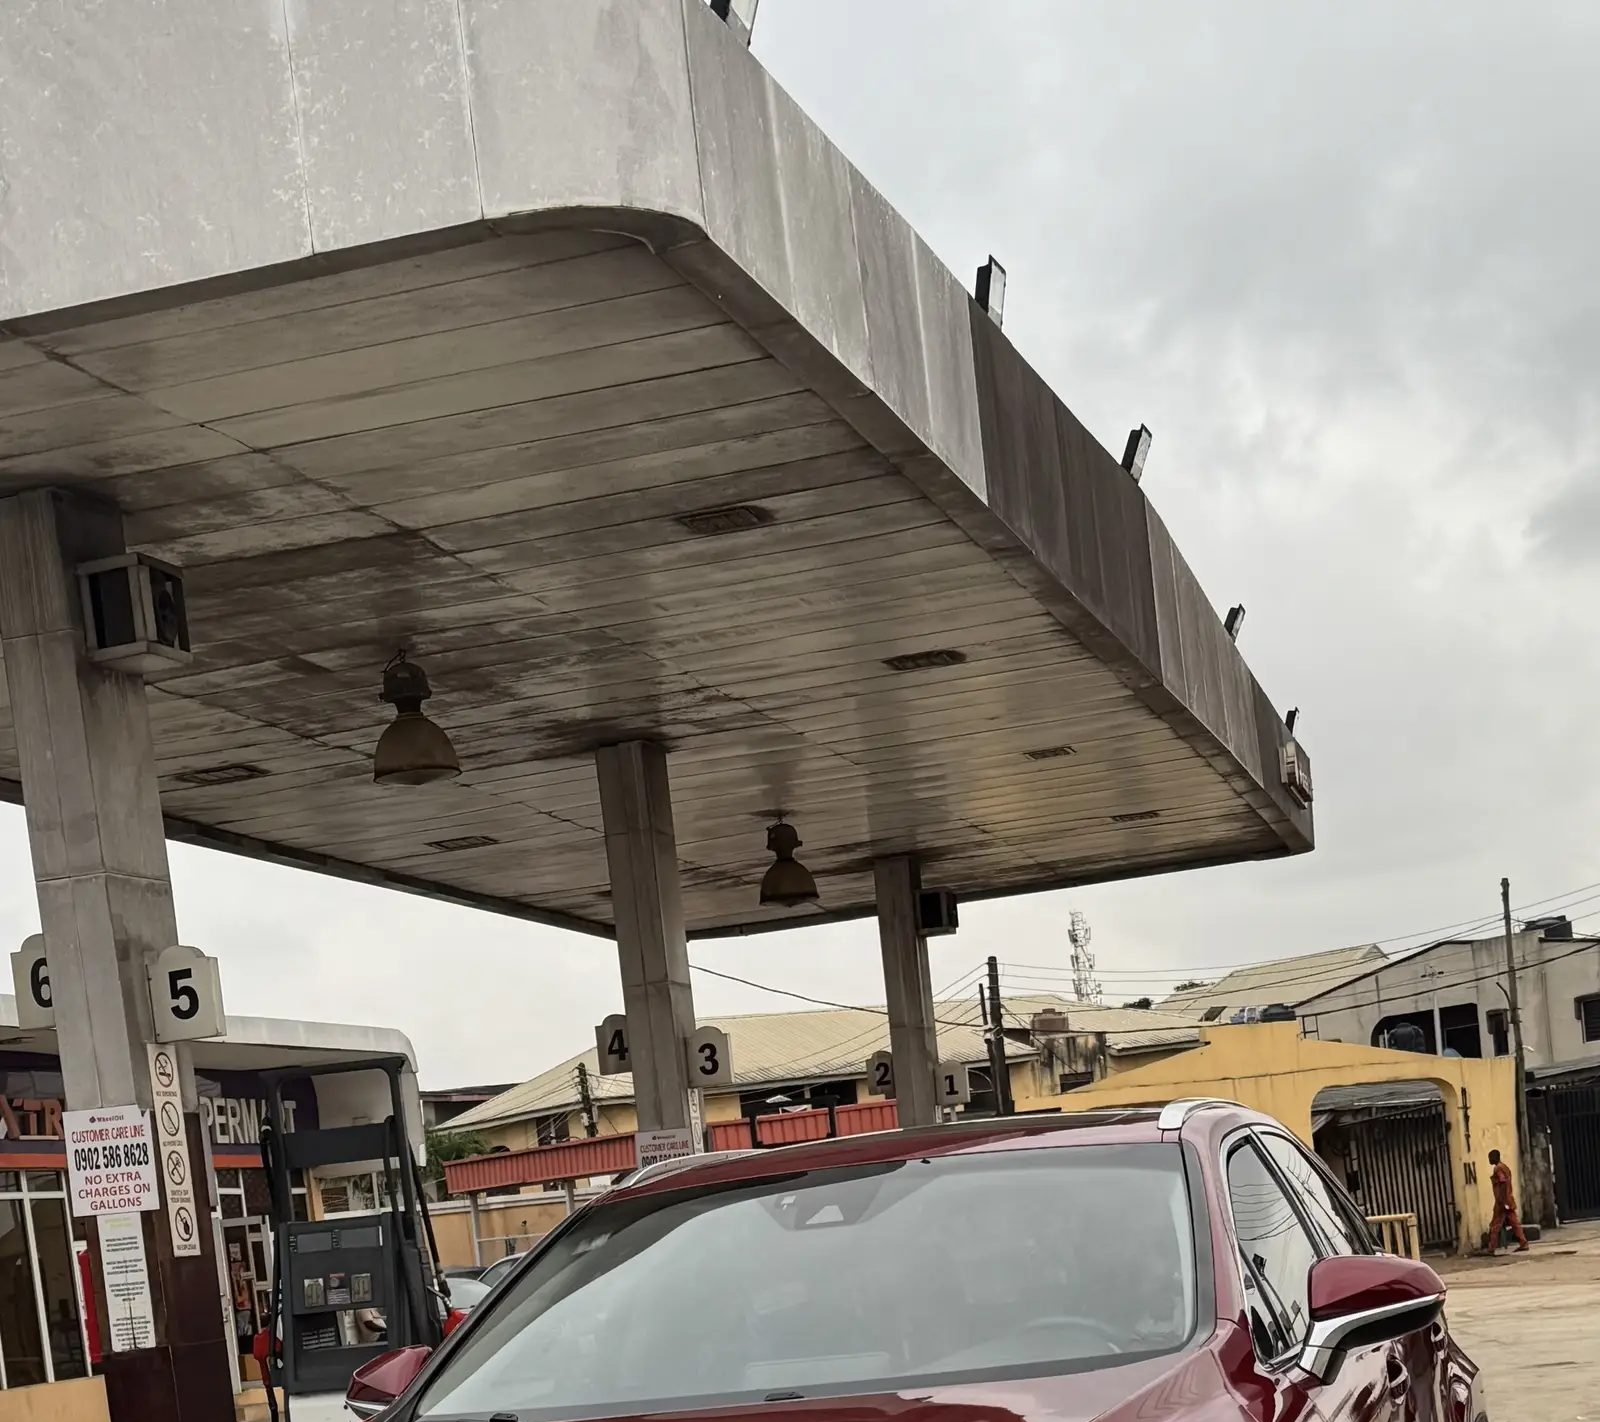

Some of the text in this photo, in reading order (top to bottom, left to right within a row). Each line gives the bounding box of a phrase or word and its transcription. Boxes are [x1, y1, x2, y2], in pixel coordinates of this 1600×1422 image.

[30, 957, 53, 1008] 6
[168, 968, 199, 1019] 5
[607, 1029, 629, 1061] 4
[698, 1043, 719, 1075] 3
[875, 1062, 891, 1087] 2
[944, 1075, 959, 1096] 1
[71, 1124, 145, 1144] CUSTOMER CARE LINE
[74, 1142, 149, 1171] 0902 586 8628
[84, 1171, 142, 1185] NO EXTRA
[1463, 1161, 1477, 1185] IN
[78, 1183, 151, 1199] CHARGES ON
[90, 1197, 142, 1210] GALLONS
